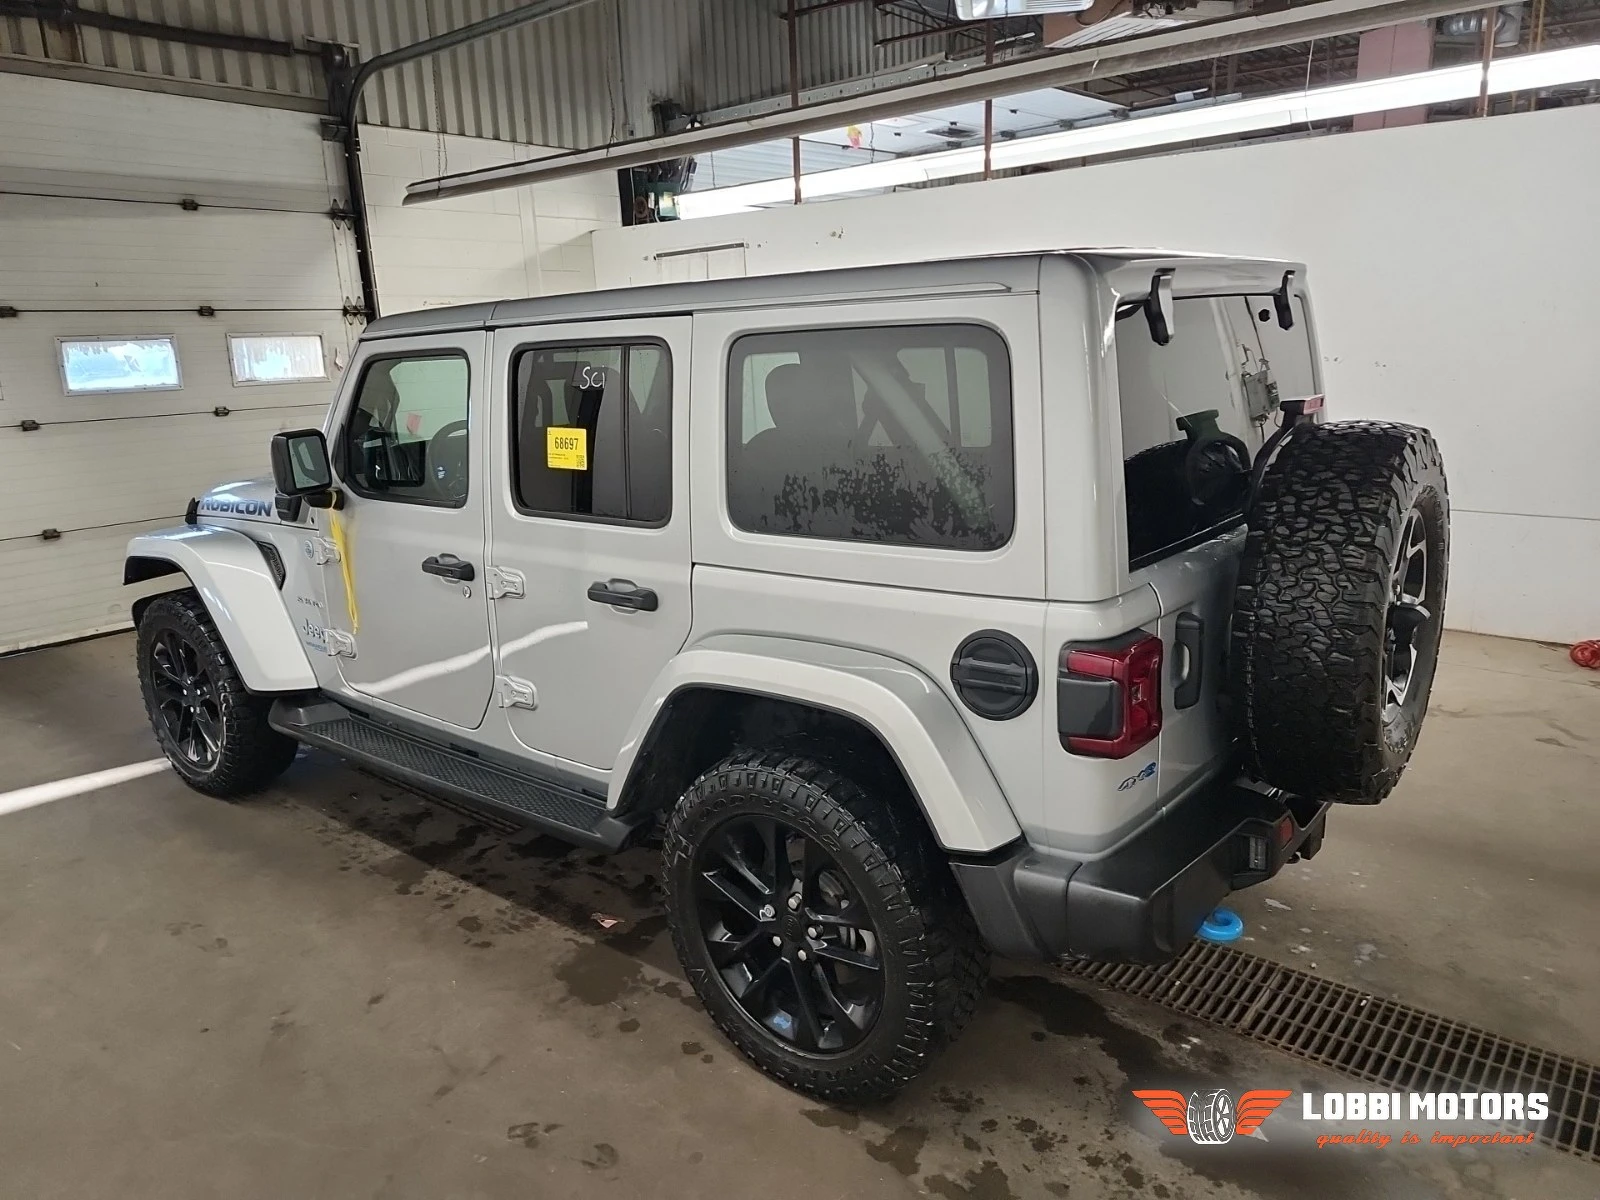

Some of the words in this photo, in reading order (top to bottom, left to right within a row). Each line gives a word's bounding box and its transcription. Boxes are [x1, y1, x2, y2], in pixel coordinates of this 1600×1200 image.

[554, 436, 579, 451] 68697
[201, 499, 273, 517] RUBICON
[303, 618, 328, 643] Jeep
